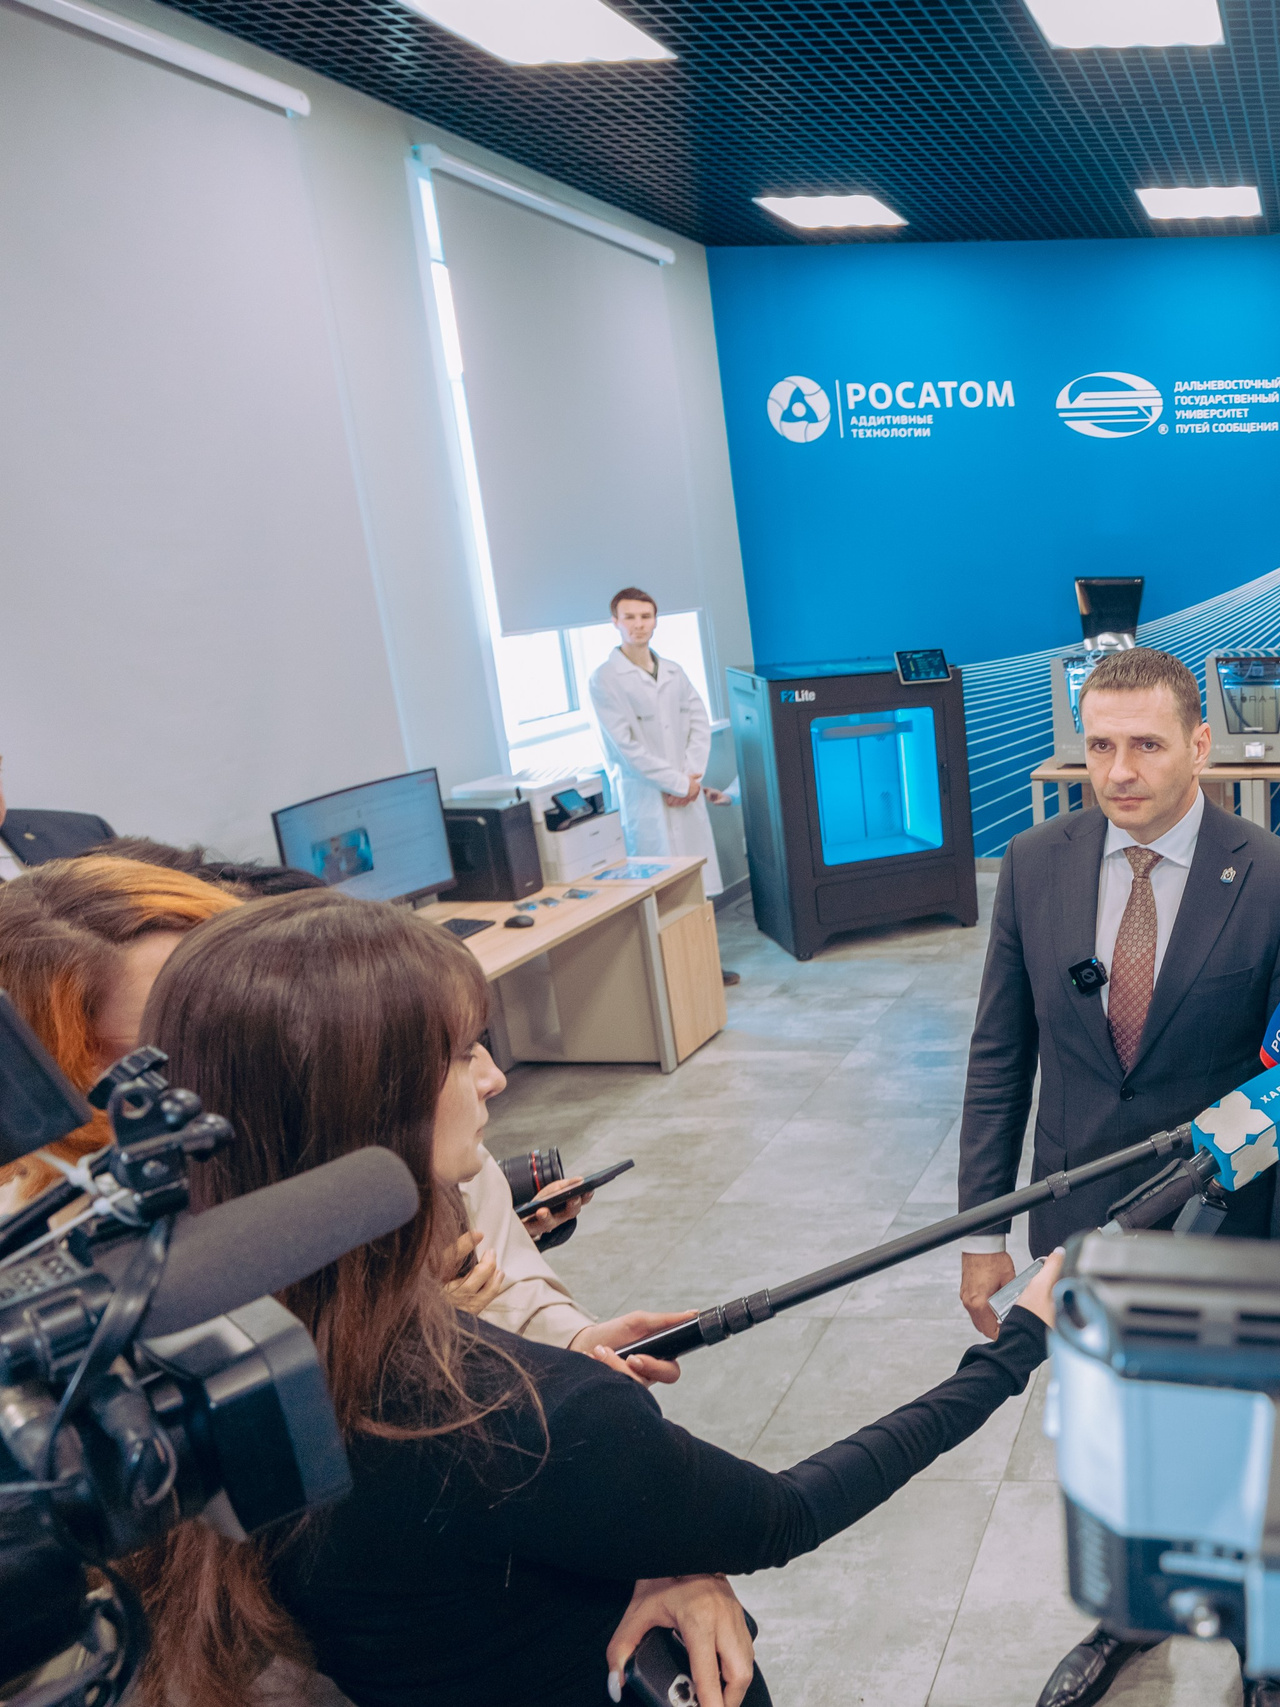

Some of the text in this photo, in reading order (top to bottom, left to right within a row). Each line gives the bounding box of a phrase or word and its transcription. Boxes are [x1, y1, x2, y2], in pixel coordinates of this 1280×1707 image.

[846, 380, 1016, 410] РОСАТОМ
[1174, 391, 1279, 406] ГОСУДАРСТВЕННЫЙ
[850, 414, 934, 426] АДДИТИВНЫЕ
[1175, 408, 1249, 420] УНИВЕРСИТЕТ
[850, 427, 931, 439] ТЕХНОЛОГИИ
[1175, 421, 1279, 434] ПУТЕЙ СООБЩЕНИЯ
[780, 690, 816, 703] F2Lite
